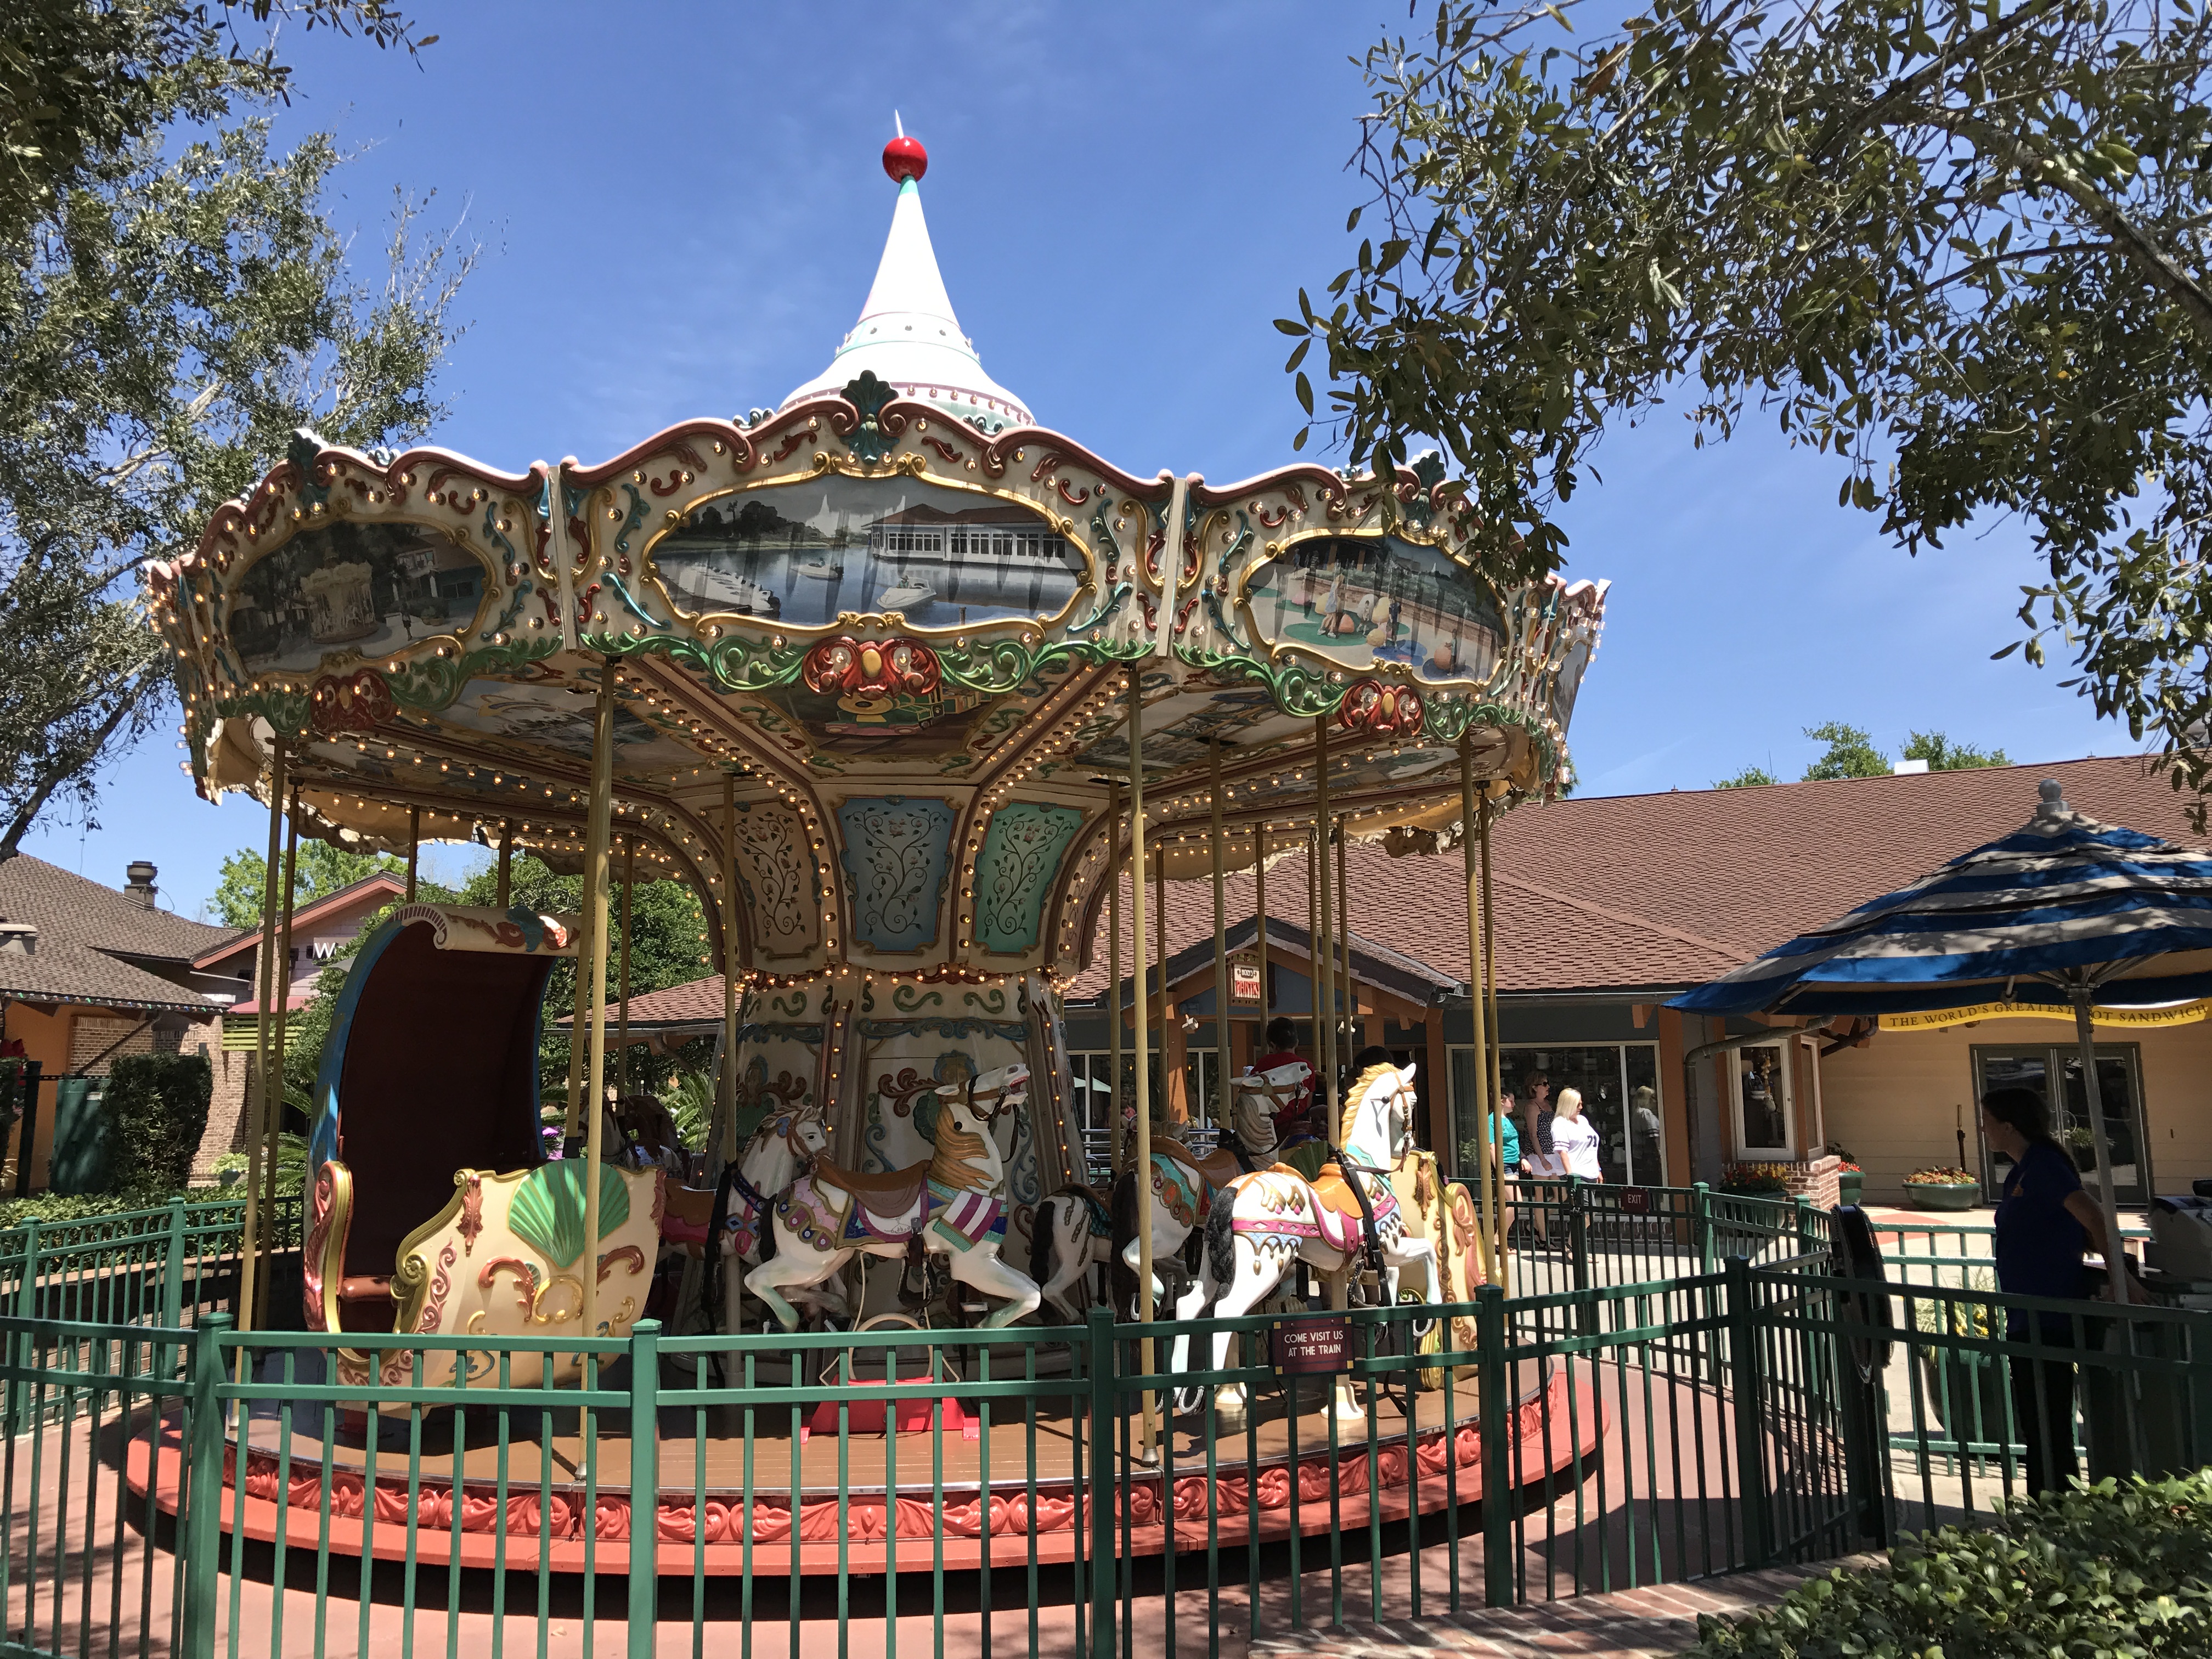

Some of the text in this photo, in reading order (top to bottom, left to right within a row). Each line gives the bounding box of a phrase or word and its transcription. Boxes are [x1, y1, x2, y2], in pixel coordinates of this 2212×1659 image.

[1235, 980, 1260, 996] PANTRY
[1889, 1017, 1919, 1026] THE
[1923, 1005, 1989, 1024] WORLD'S
[2119, 1004, 2207, 1023] SANDWICH
[1587, 1135, 1597, 1148] 71
[1627, 1194, 1642, 1204] EXIT
[1284, 1330, 1344, 1344] COME VISIT US
[1288, 1344, 1341, 1357] AT THE TRAIN
